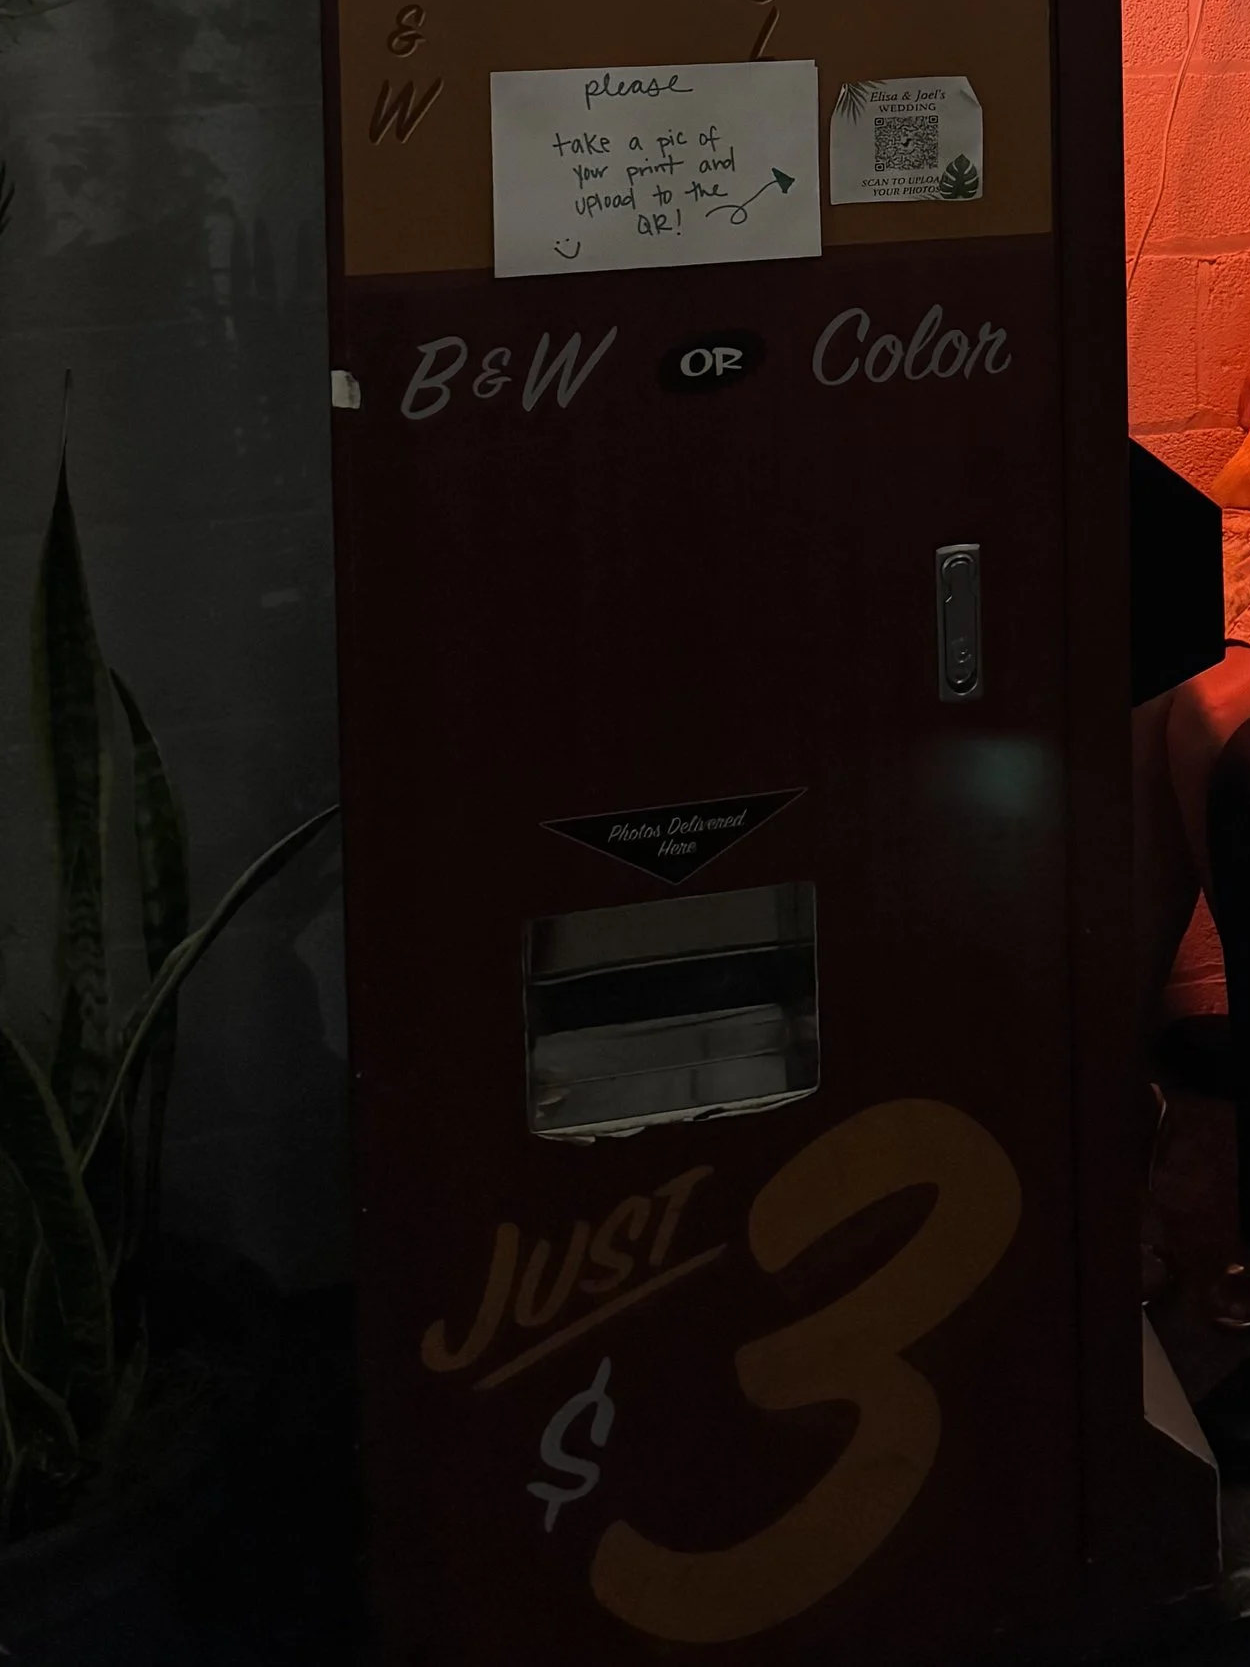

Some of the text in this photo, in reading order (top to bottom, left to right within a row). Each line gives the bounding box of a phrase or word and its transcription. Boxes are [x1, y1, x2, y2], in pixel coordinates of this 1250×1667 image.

[584, 72, 694, 110] please
[869, 89, 946, 103] Elisa & Joel's
[879, 103, 937, 113] WEDDING
[552, 125, 721, 157] take a pic of
[573, 146, 736, 188] your print and
[862, 176, 941, 187] SCAN TO UPLOA
[575, 180, 728, 217] upload to the
[872, 188, 900, 197] YOUR
[637, 208, 682, 236] QR!
[679, 346, 743, 378] OR
[810, 304, 1013, 387] Color
[607, 807, 749, 844] Photos Delivered
[656, 839, 698, 859] Here
[420, 1164, 716, 1374] JUST
